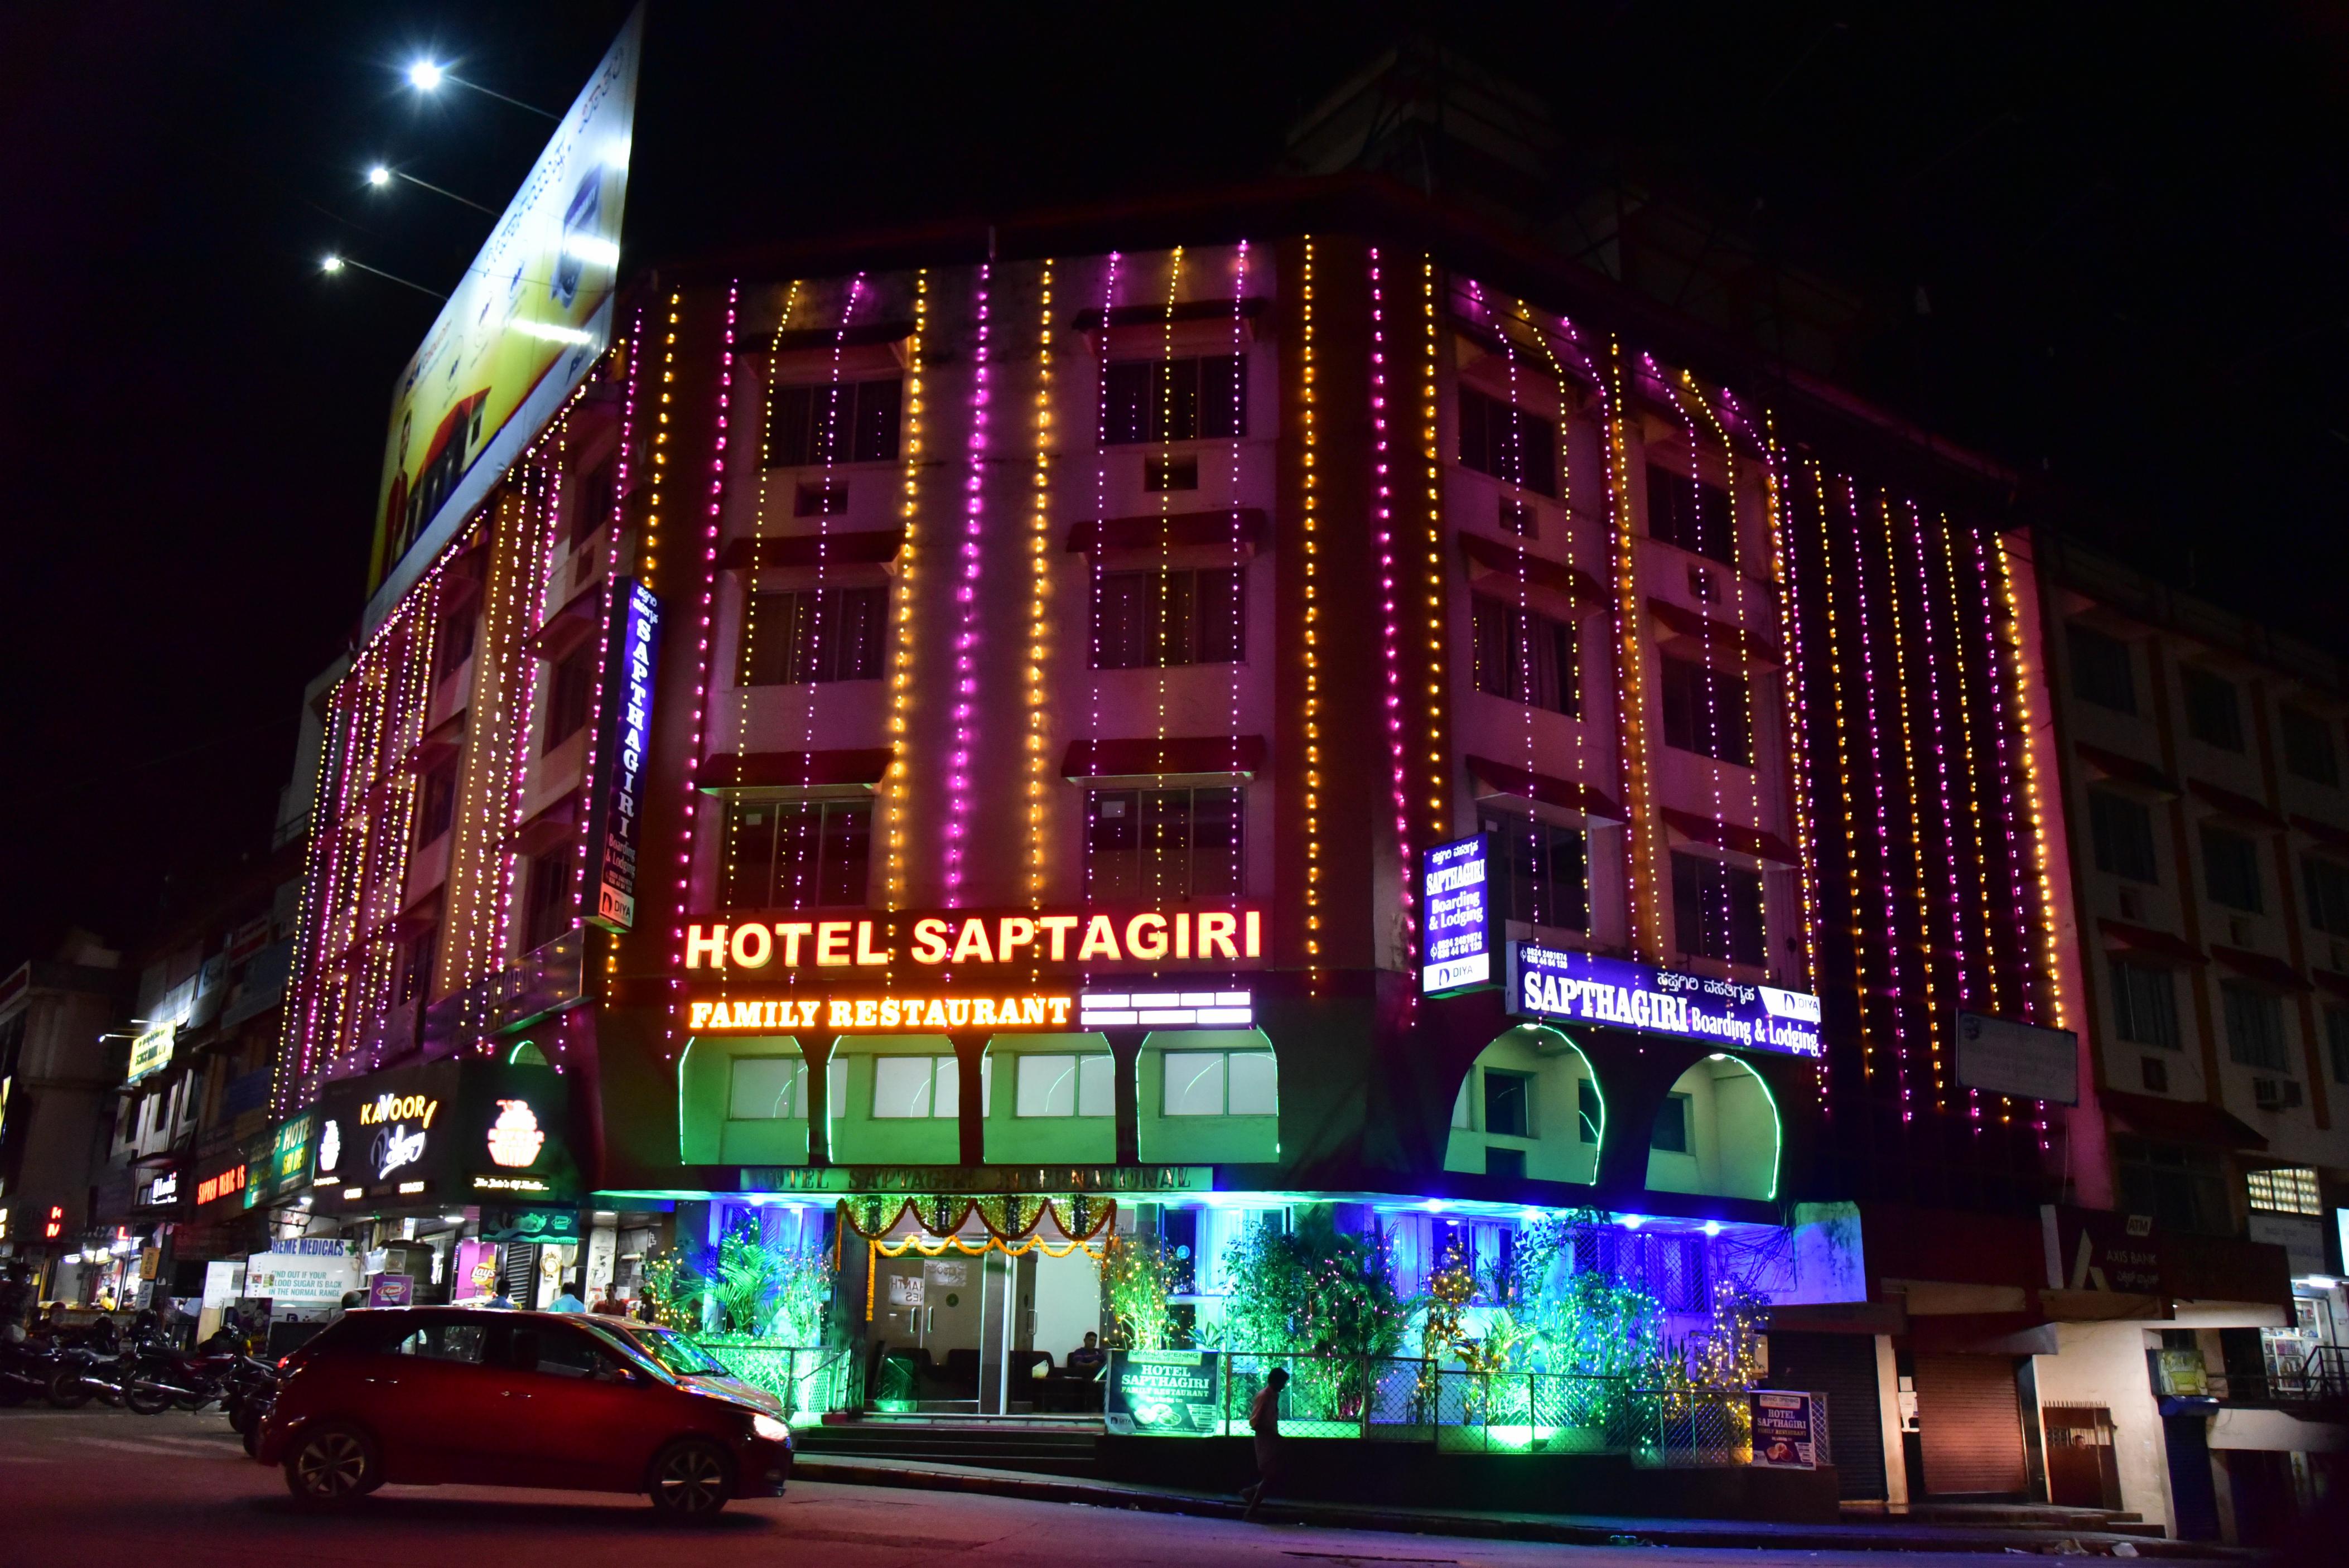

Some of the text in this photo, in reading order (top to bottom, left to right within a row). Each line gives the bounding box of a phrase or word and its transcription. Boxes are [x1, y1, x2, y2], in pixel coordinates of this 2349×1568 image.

[618, 618, 651, 838] SAPTHAGIRI
[609, 833, 636, 863] Boarding
[612, 851, 636, 879] Lodging
[1426, 859, 1485, 896] SAPTHAGIRI
[615, 900, 631, 918] DIYA
[1432, 891, 1480, 914] Boarding
[1429, 906, 1483, 930] & Lodging
[686, 911, 1260, 968] HOTEL SAPTAGIRI
[1453, 966, 1473, 977] DIYA
[690, 997, 1070, 1028] FAMILY RESTAURANT
[1525, 971, 1819, 1056] SAPTHAGIRI Boarding & Lodging
[1798, 998, 1819, 1010] DIYA
[361, 1093, 426, 1125] KAVOOR
[283, 1116, 314, 1152] HOTEL
[2129, 1219, 2149, 1232] ATM
[298, 1239, 344, 1256] MEDICALS
[2106, 1249, 2157, 1266] AXIS BANK
[1141, 1364, 1190, 1377] HOTEL
[1122, 1374, 1209, 1388] SAPTHAGIRI
[1121, 1386, 1209, 1397] FAMILY RESTAURANT
[1757, 1417, 1806, 1429] SAPTHAGIRI
[1768, 1409, 1795, 1419] HOTEL
